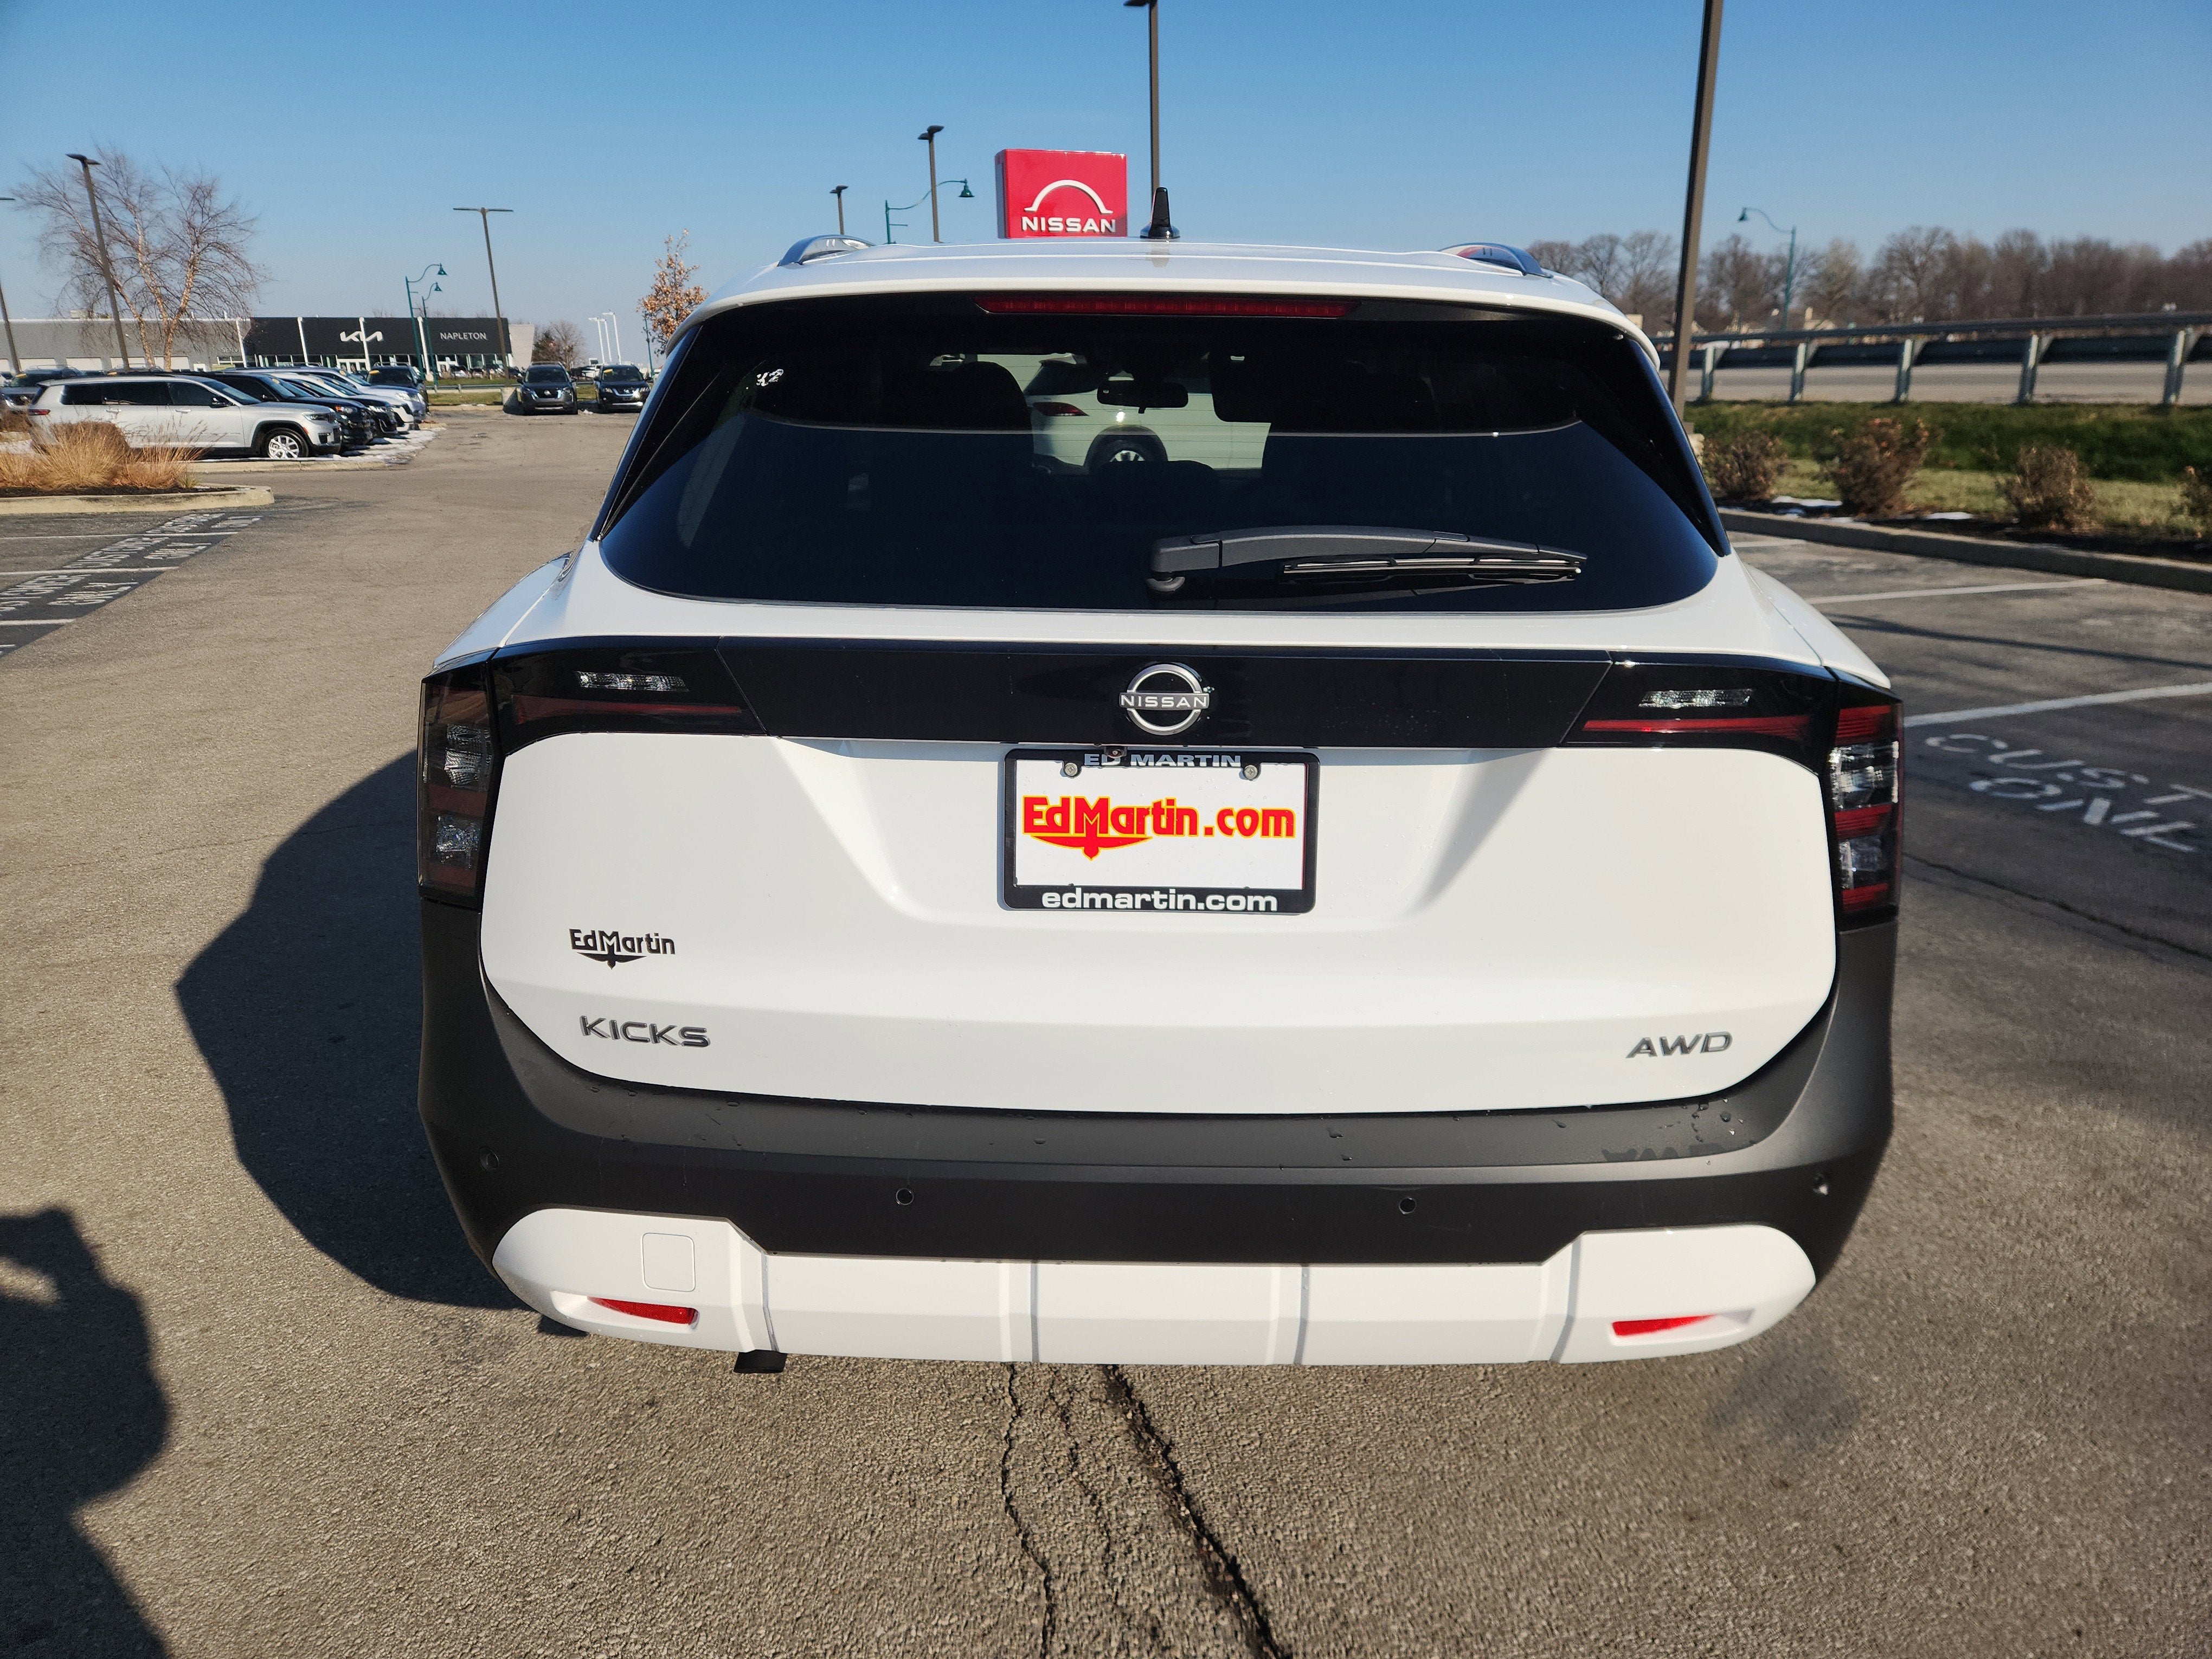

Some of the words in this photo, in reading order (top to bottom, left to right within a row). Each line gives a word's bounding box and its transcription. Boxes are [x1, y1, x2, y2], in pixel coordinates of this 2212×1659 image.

[1021, 216, 1116, 233] NISSAN
[440, 332, 487, 340] NAPLETON
[1120, 694, 1207, 708] NISSAN
[1084, 753, 1121, 766] ED
[1130, 754, 1242, 767] MARTIN
[1023, 795, 1296, 838] EdMartin.com
[1041, 888, 1278, 911] edmartin.com
[569, 928, 676, 955] EdMartin
[579, 1015, 711, 1048] KICKS
[1625, 1031, 1733, 1059] AWD
